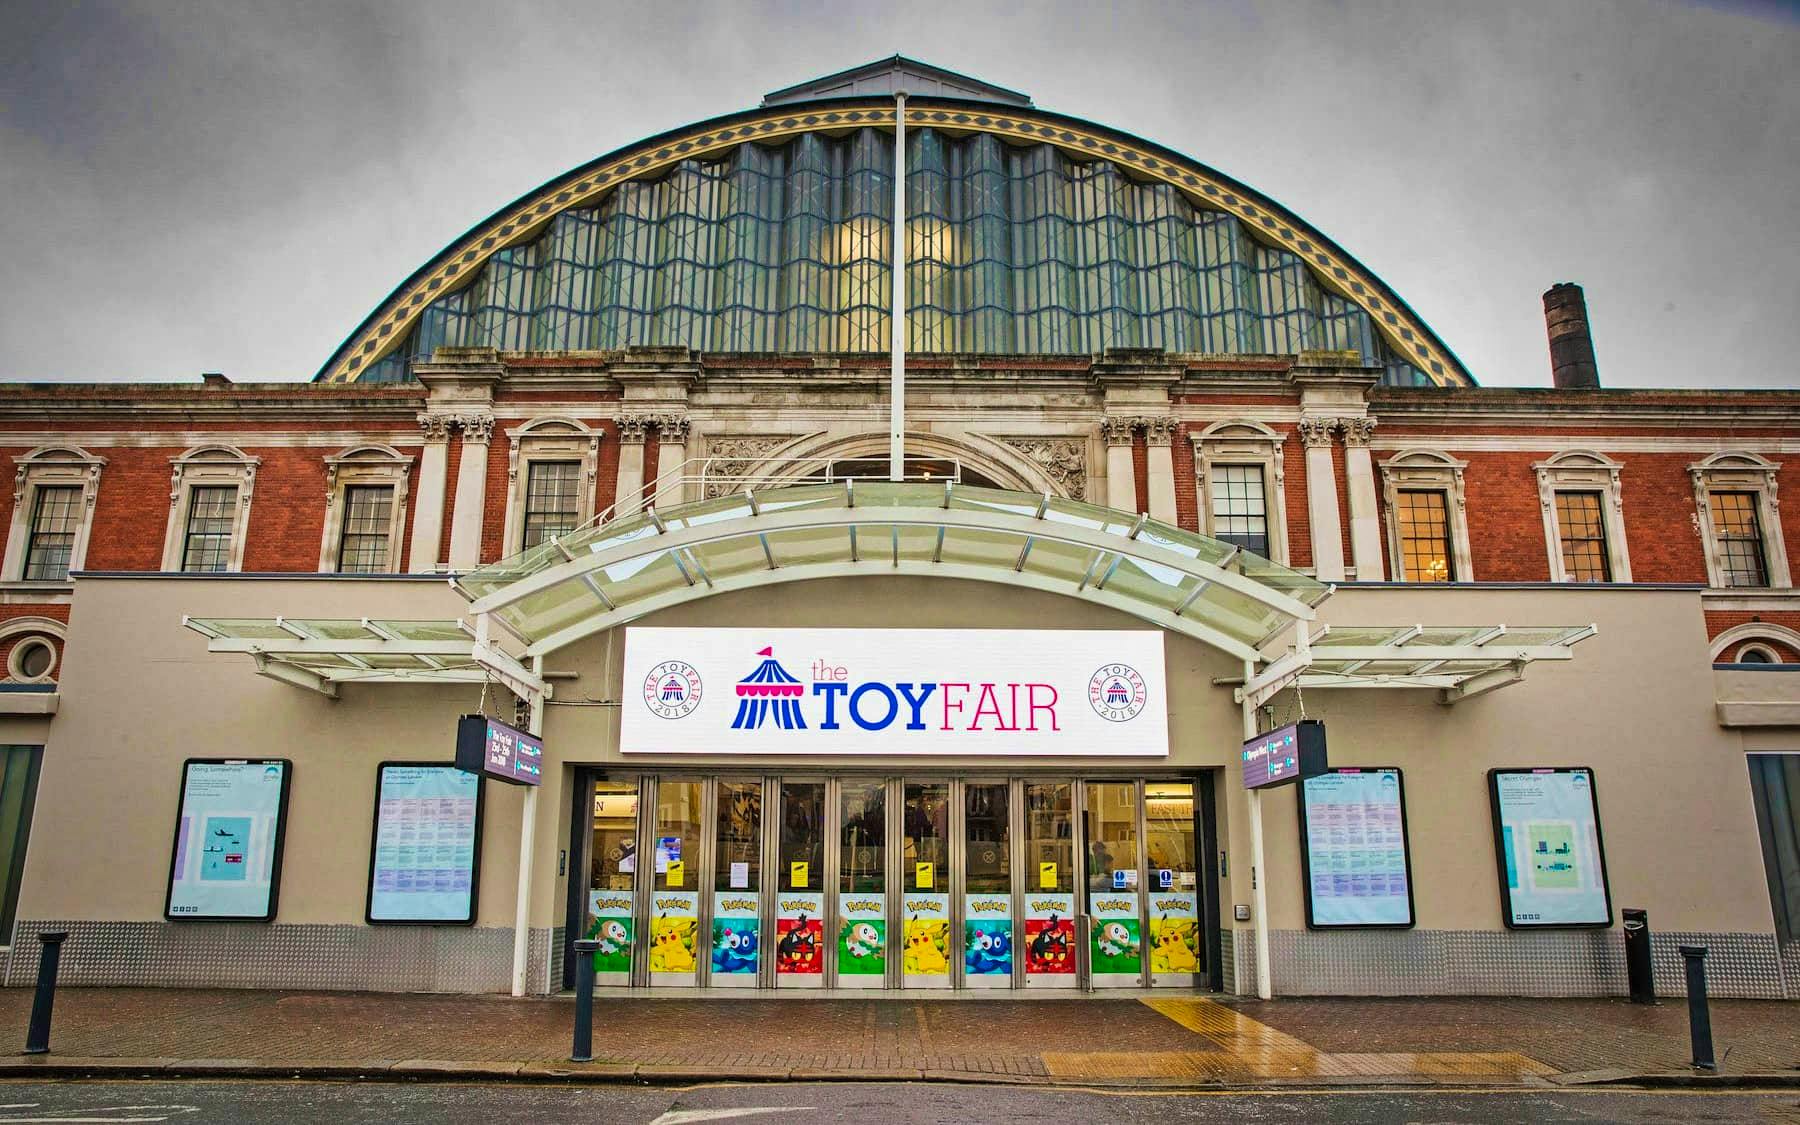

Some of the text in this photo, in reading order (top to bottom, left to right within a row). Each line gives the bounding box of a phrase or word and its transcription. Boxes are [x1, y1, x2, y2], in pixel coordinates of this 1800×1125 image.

[811, 659, 848, 682] the
[646, 674, 659, 701] THE
[1090, 677, 1103, 704] THE
[655, 703, 690, 717] 2018
[1100, 706, 1136, 720] 2018
